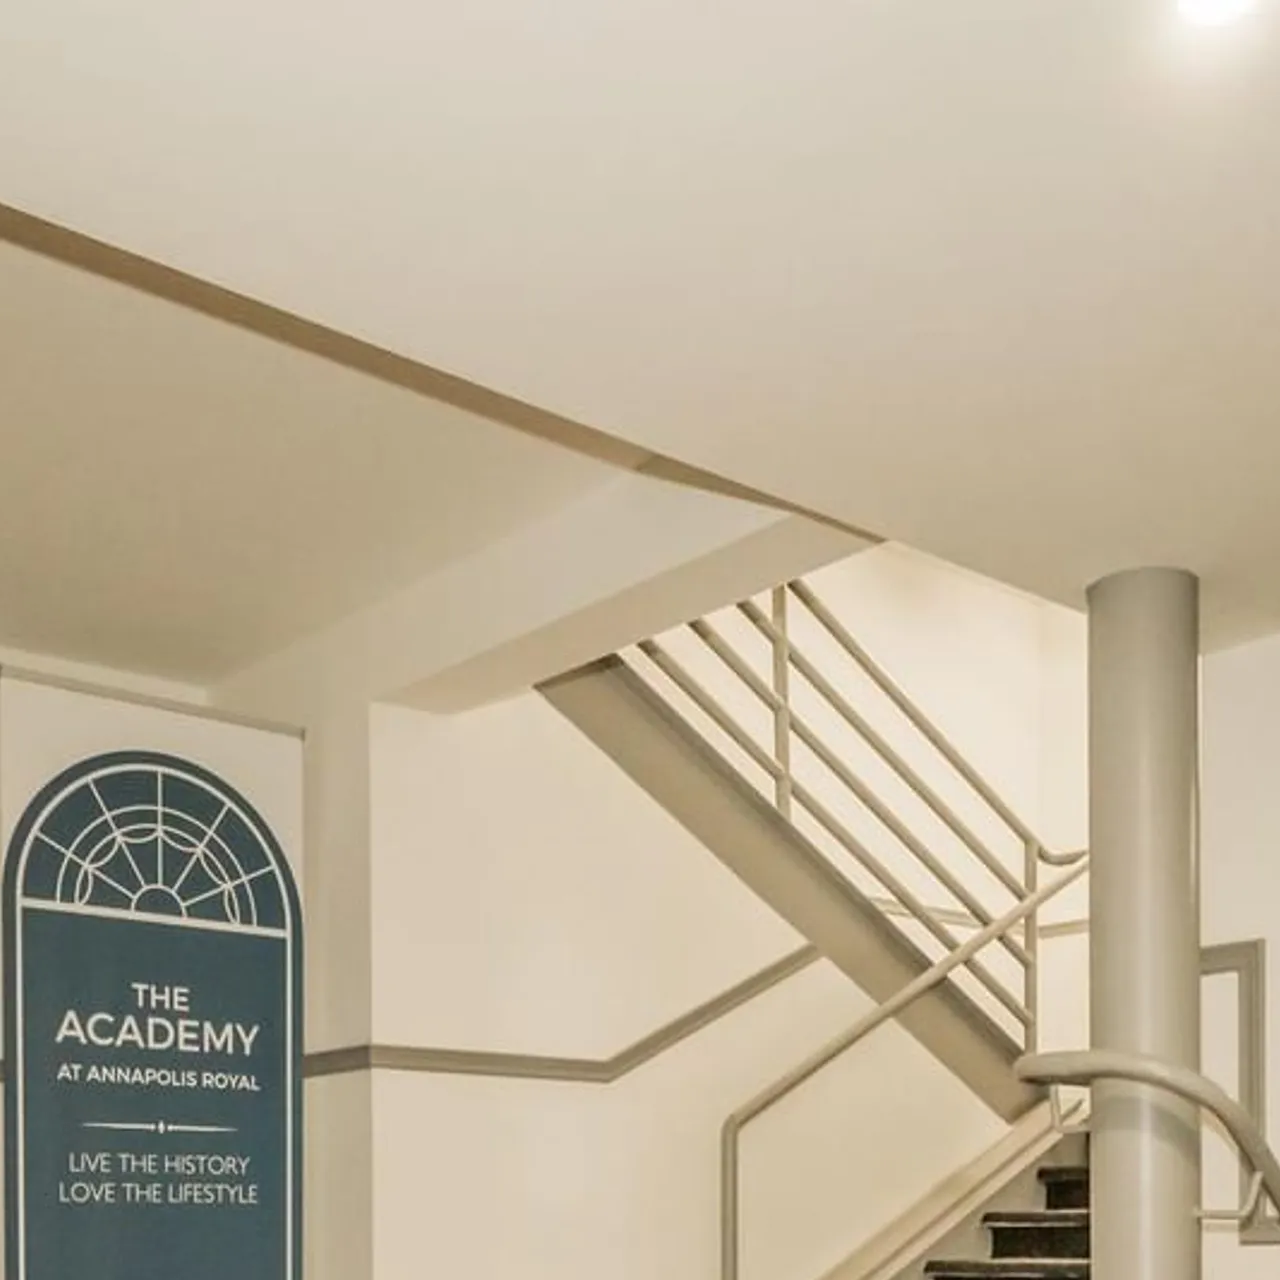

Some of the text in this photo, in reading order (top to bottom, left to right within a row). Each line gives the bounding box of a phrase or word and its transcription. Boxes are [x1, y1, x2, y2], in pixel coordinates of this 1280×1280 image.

[131, 981, 190, 1012] THE
[55, 1009, 260, 1057] ACADEMY
[56, 1062, 261, 1092] AT ANNAPOLIS ROYAL
[69, 1152, 250, 1177] LIVE THE HISTORY
[58, 1181, 258, 1204] LOVE THE LIFESTYLE
